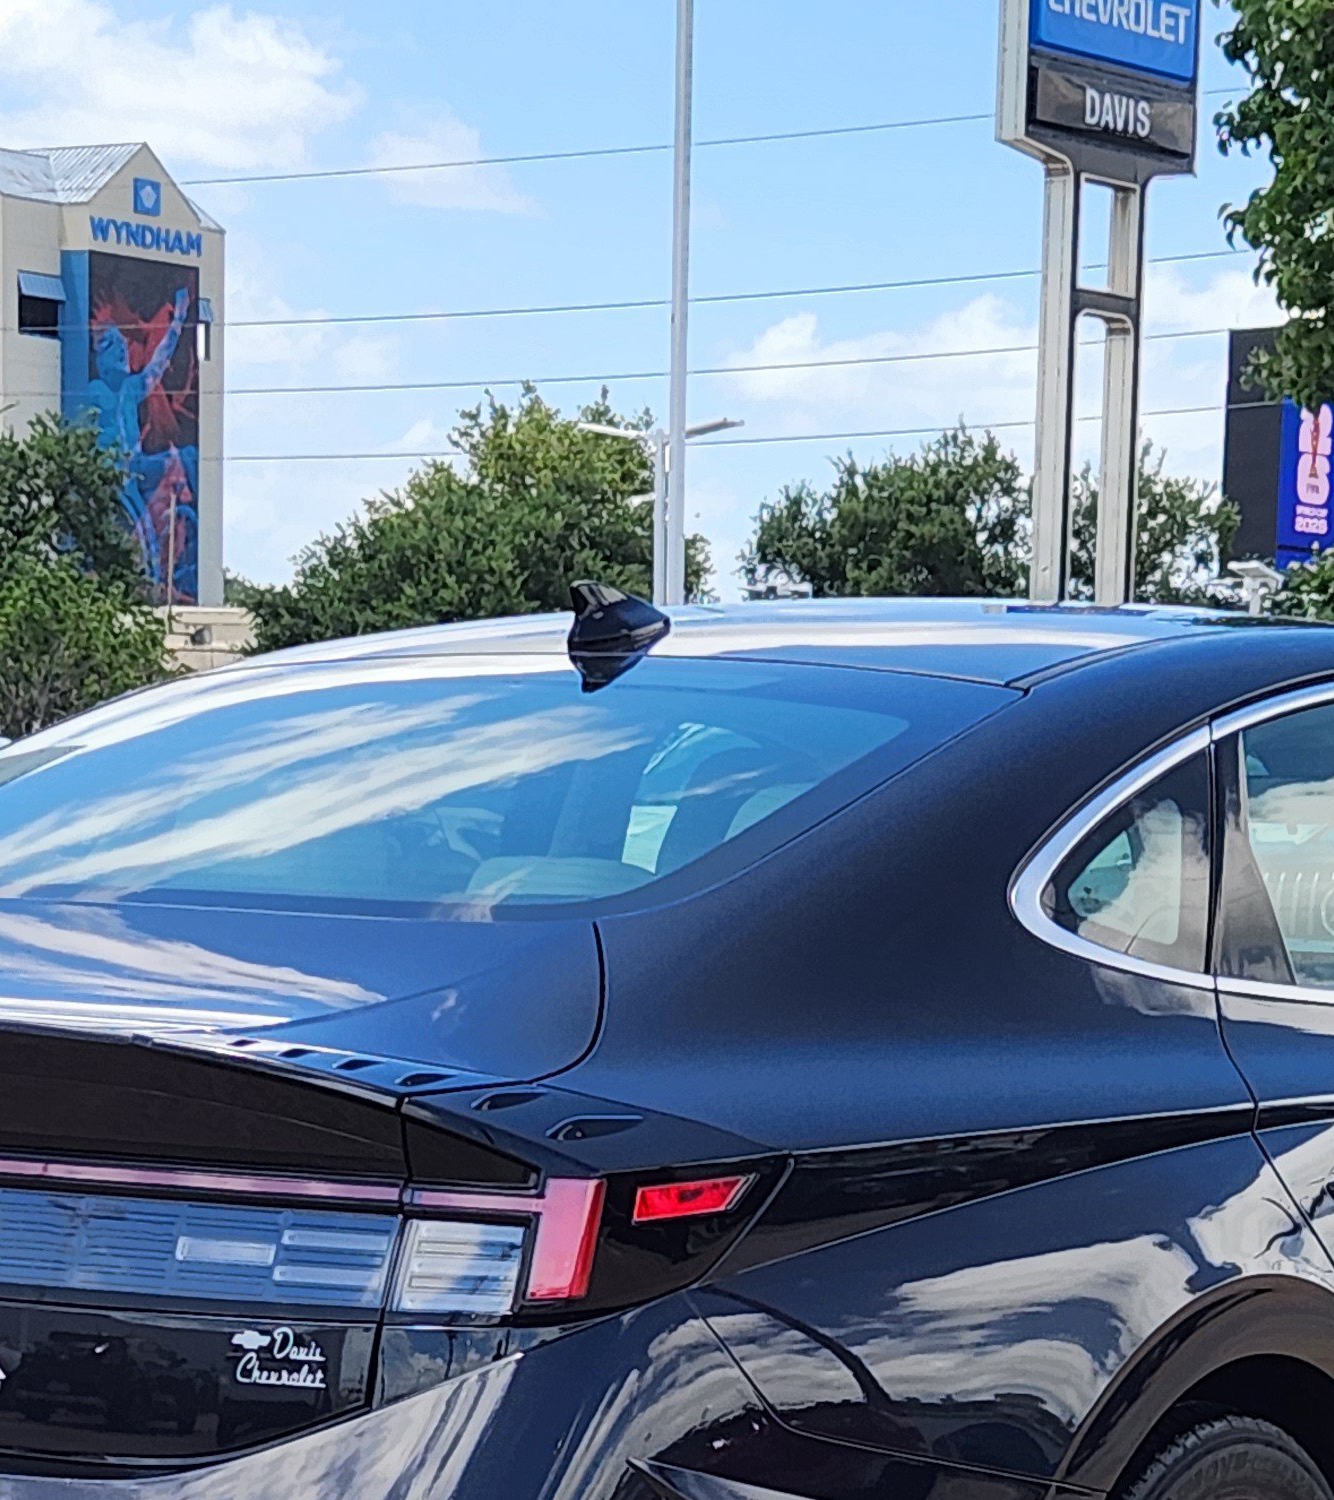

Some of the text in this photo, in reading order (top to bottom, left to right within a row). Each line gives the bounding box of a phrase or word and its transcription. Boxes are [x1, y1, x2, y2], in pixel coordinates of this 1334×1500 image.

[1084, 86, 1151, 138] DAVIS
[89, 214, 202, 257] WYNDHAM
[273, 1327, 326, 1361] Davis
[236, 1352, 327, 1388] Chevrolet
